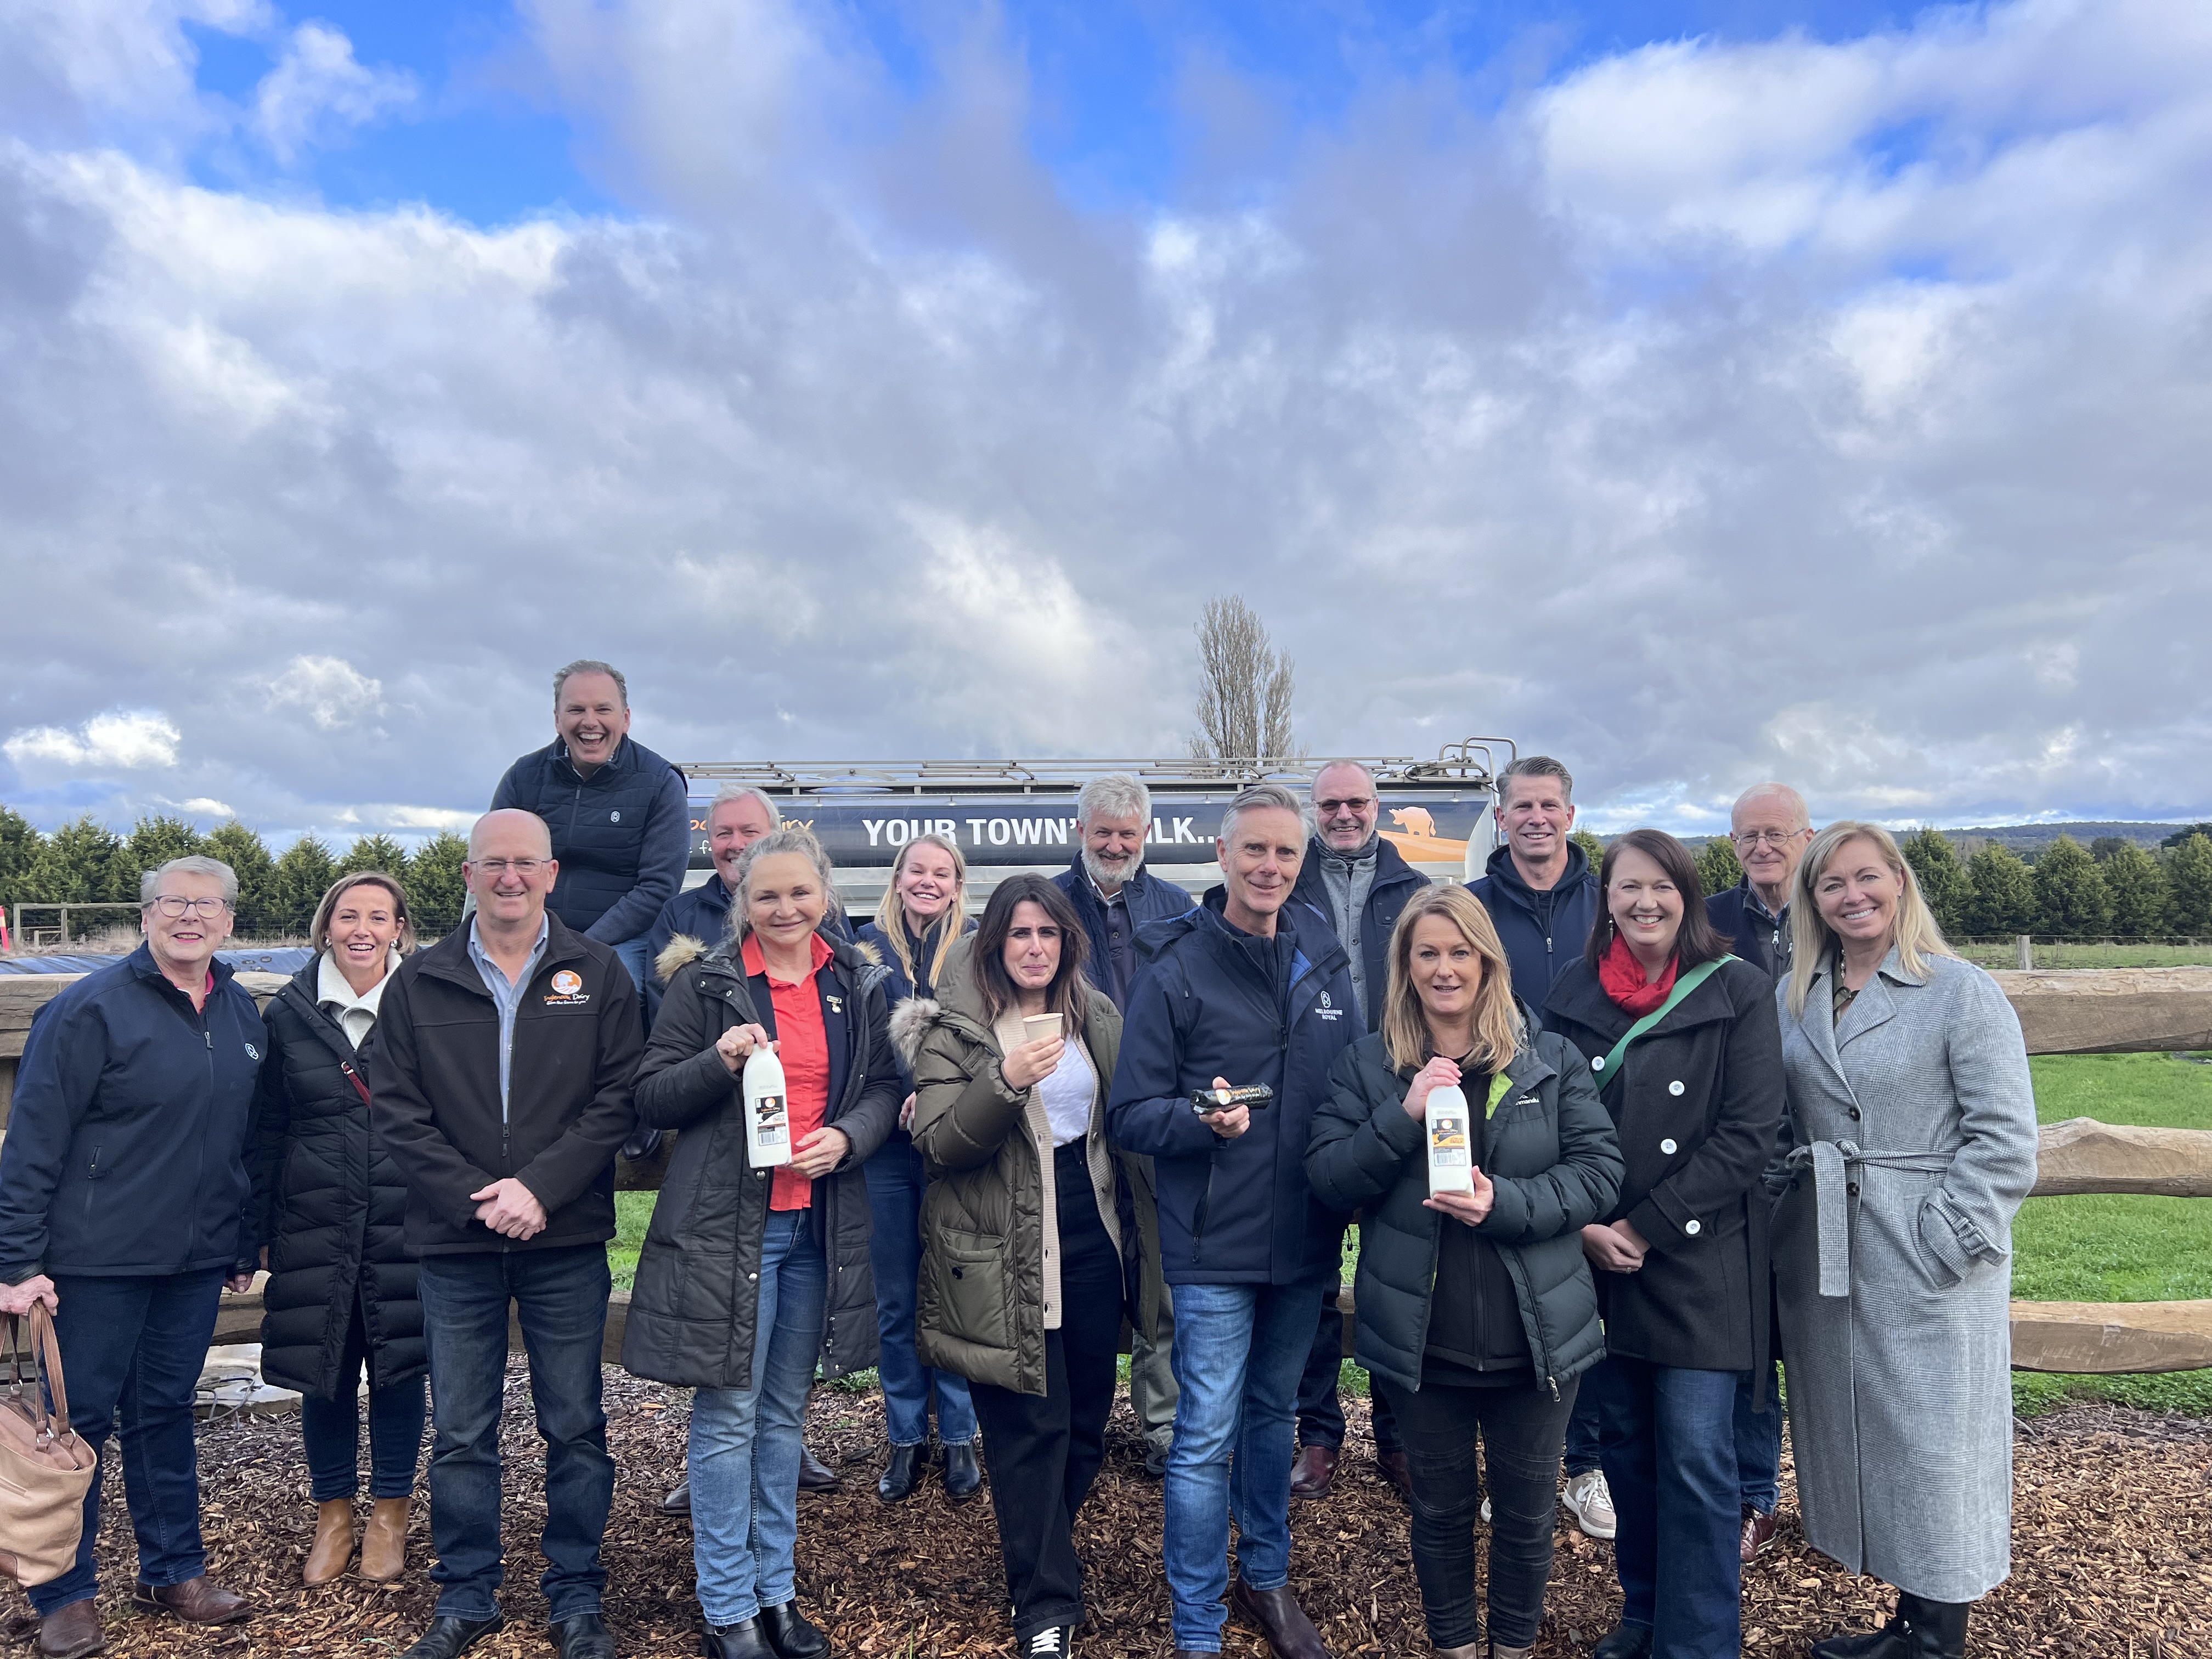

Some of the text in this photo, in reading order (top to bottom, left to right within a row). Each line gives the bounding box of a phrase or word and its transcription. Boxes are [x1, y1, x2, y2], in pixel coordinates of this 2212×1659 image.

[780, 815, 814, 832] iry
[862, 819, 957, 846] YOUR
[966, 817, 1076, 845] TOWN'
